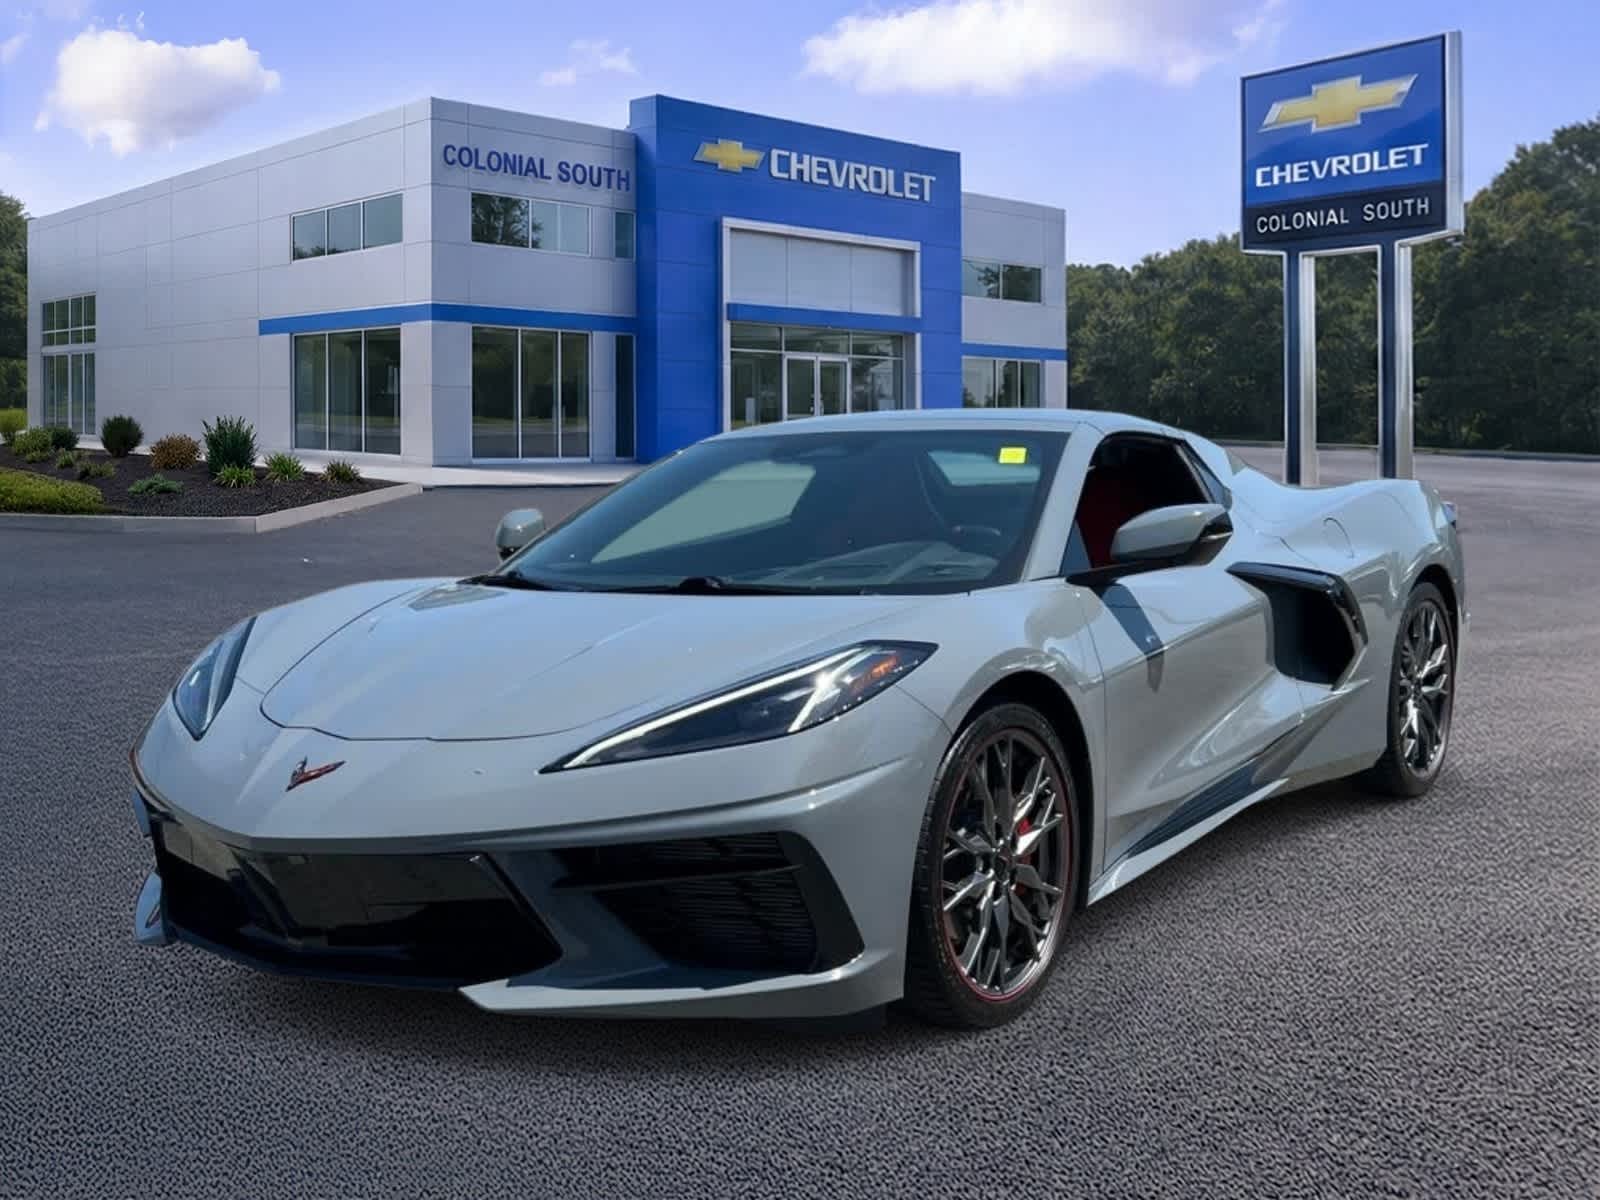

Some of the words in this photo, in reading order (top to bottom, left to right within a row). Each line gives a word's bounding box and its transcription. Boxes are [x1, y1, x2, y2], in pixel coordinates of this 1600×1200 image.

[443, 144, 551, 181] COLONIAL
[558, 161, 630, 192] SOUTH
[770, 148, 936, 203] CHEVROLET
[1256, 143, 1428, 187] CHEVROLET
[1256, 208, 1349, 233] COLONIAL
[1363, 197, 1429, 221] SOUTH
